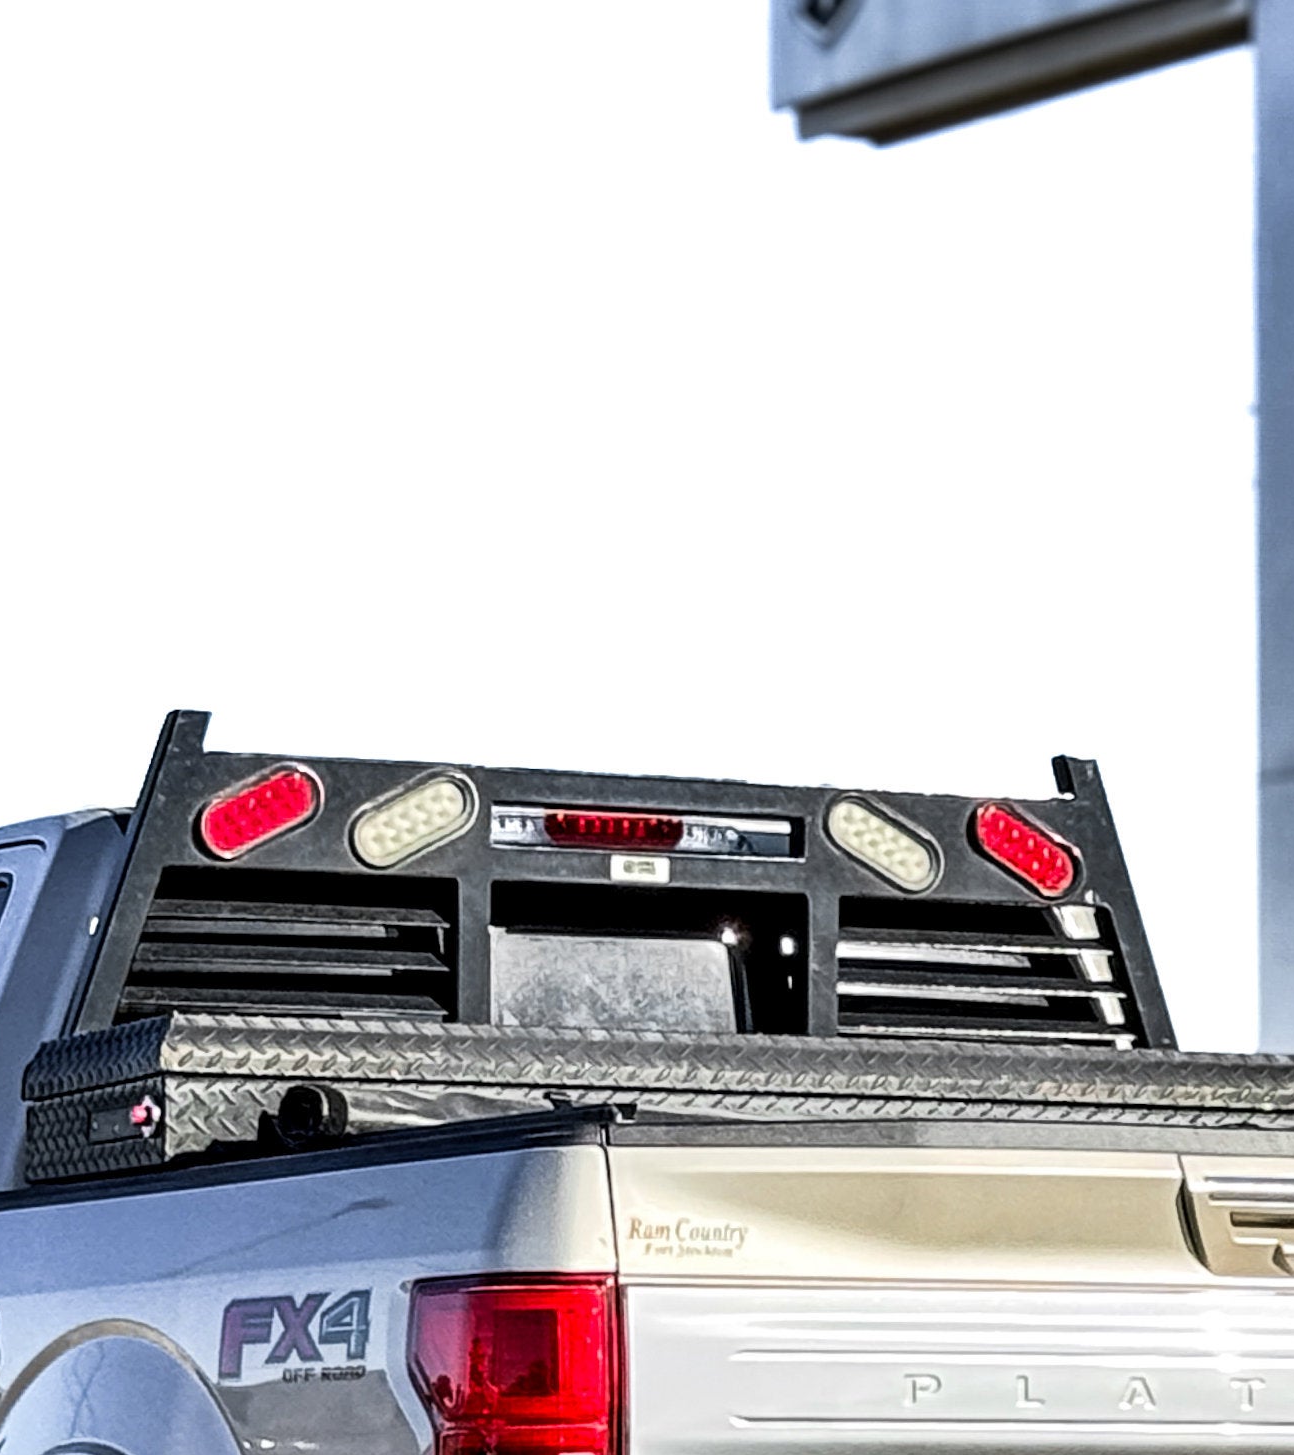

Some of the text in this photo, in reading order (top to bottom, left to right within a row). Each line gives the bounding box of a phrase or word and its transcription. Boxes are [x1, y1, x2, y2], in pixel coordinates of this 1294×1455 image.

[628, 1217, 749, 1250] Ram Country
[218, 1287, 373, 1380] FX4
[282, 1365, 367, 1384] OFF ROAD
